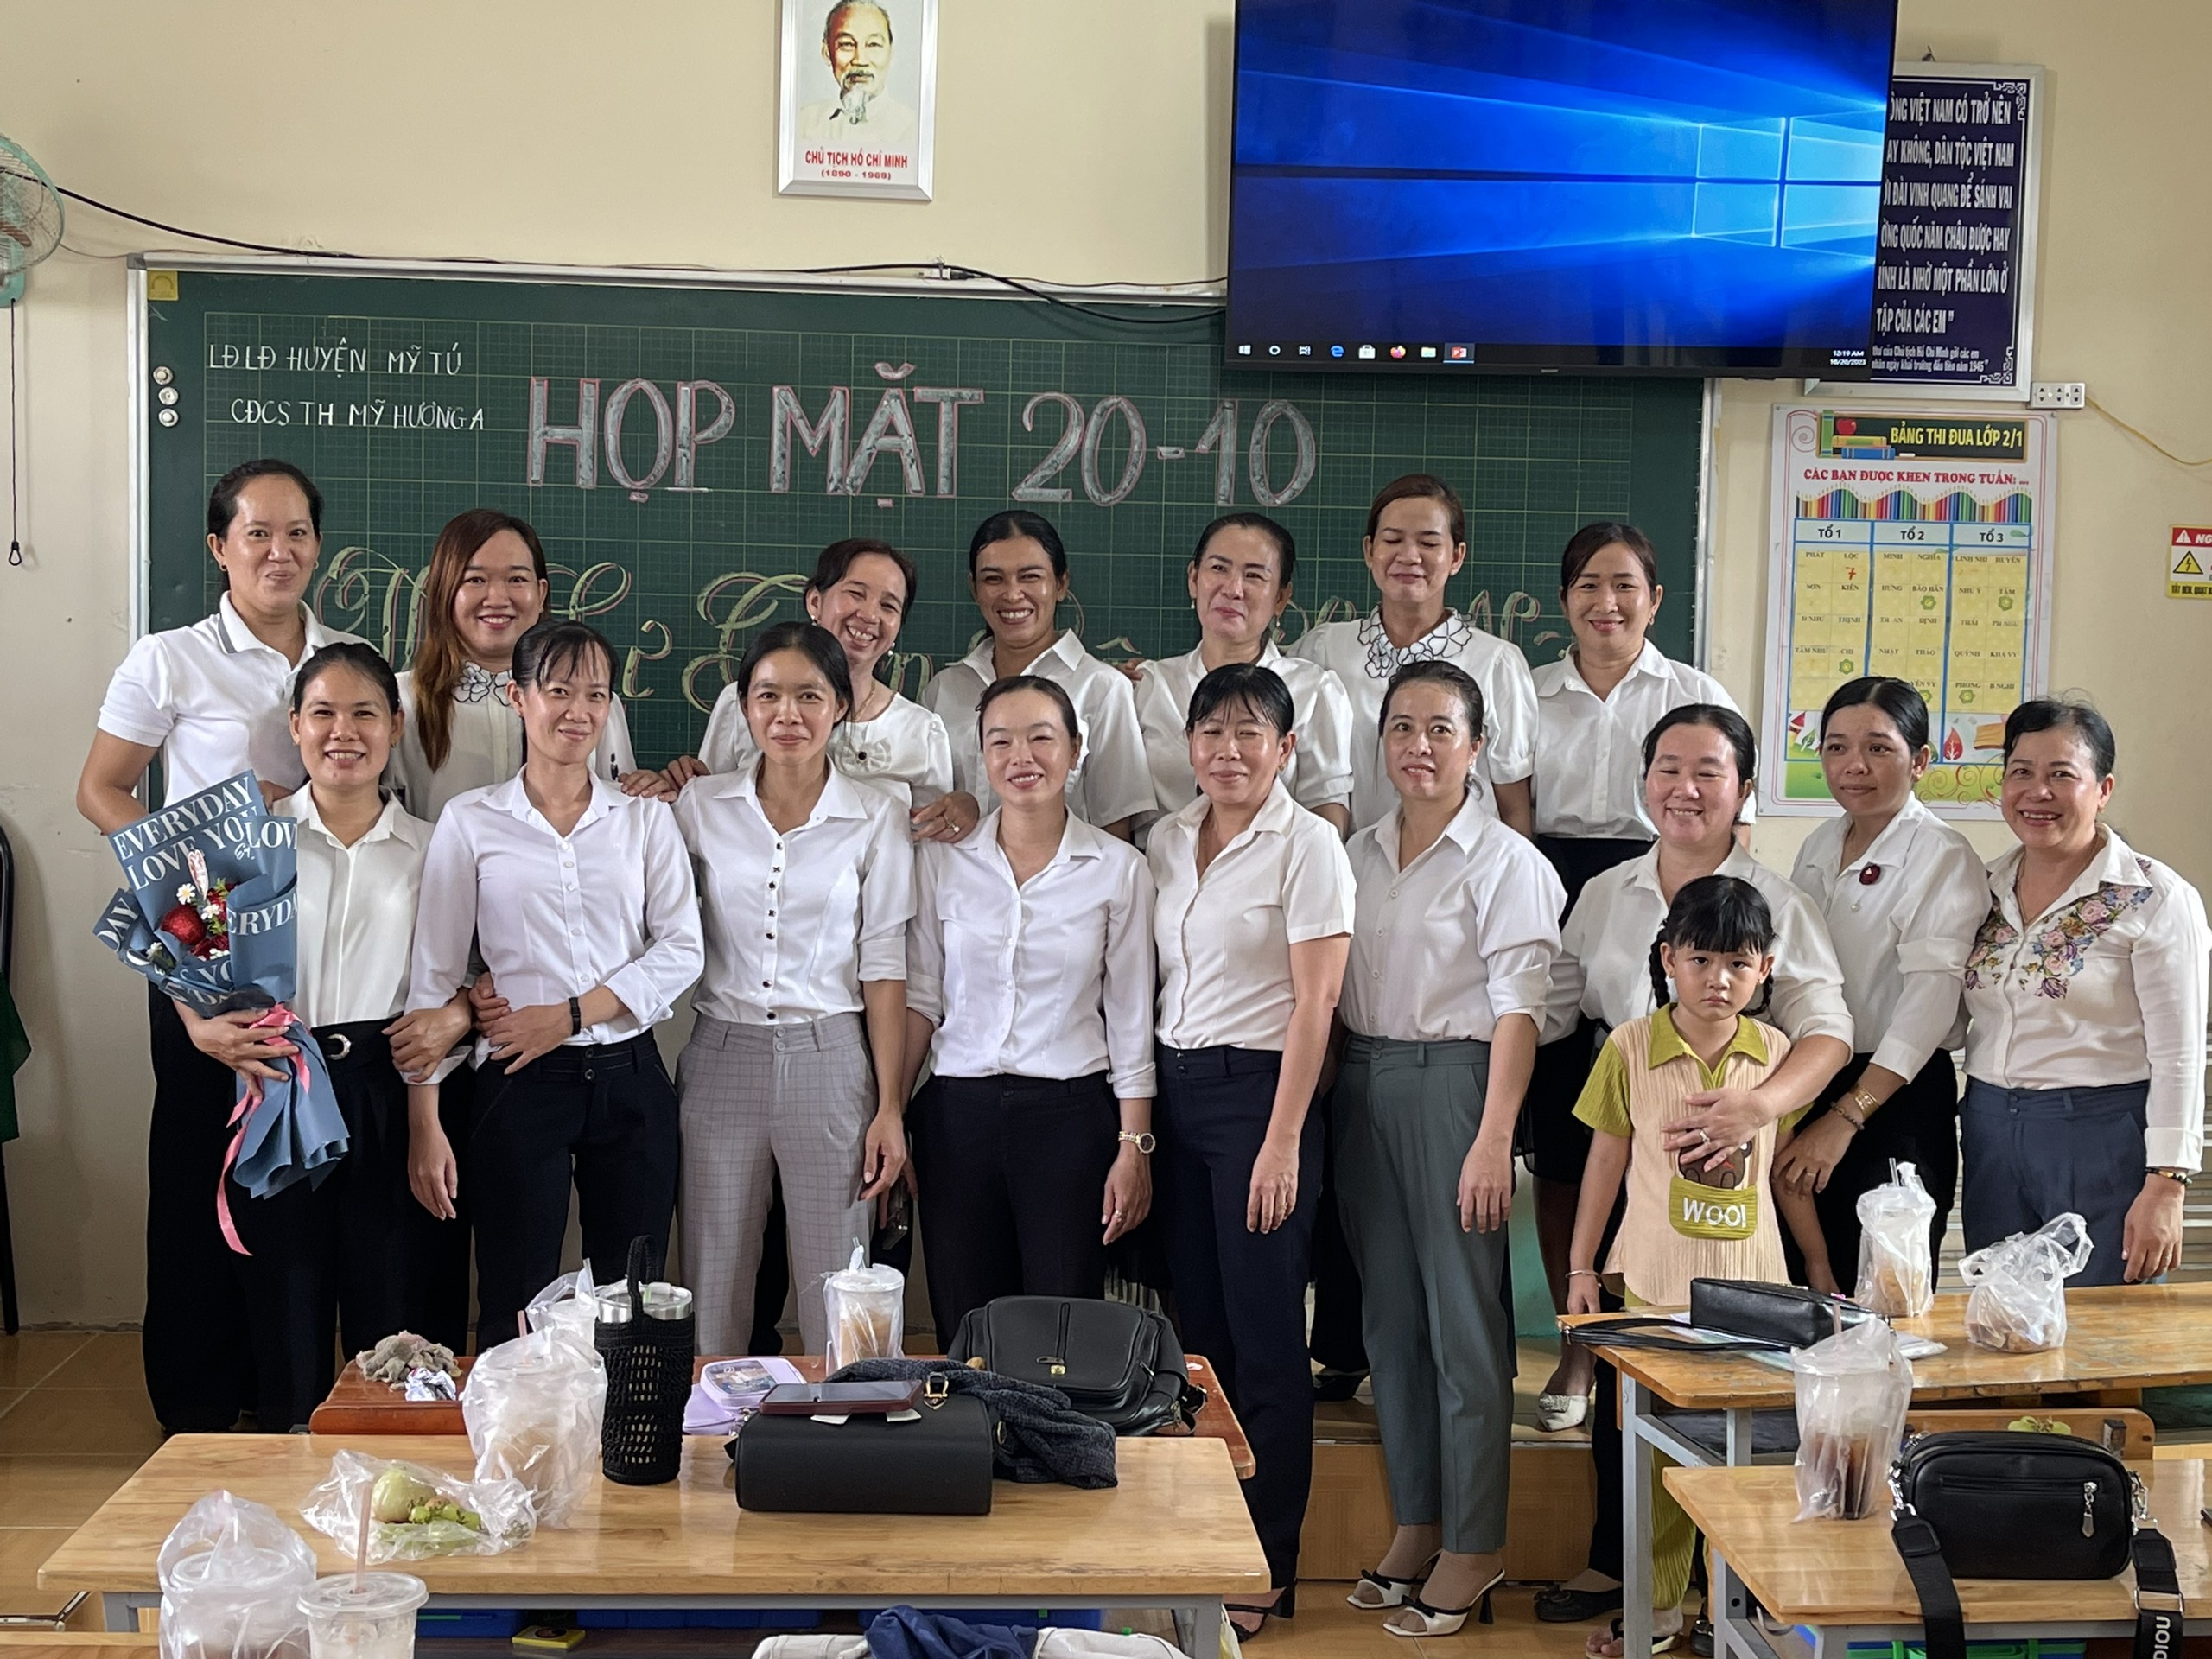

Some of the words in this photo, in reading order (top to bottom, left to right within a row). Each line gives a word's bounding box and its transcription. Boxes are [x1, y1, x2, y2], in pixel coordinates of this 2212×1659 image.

[1910, 92, 1931, 126] VIỆT
[1932, 99, 1953, 123] NAM
[1955, 92, 1968, 123] CÓ
[1971, 91, 1990, 124] TRỞ
[1992, 94, 2012, 124] NÊN
[805, 146, 824, 164] CHỦ
[827, 152, 849, 168] TỊCH
[851, 147, 863, 166] HỒ
[866, 150, 881, 167] CHÍ
[884, 155, 907, 168] MINH
[1886, 139, 1899, 163] AY
[1900, 133, 1932, 169] KHÔNG,
[1935, 135, 1953, 164] DÂN
[1955, 135, 1972, 169] TỘC
[1974, 136, 1993, 171] VIỆT
[1994, 143, 2015, 167] NAM
[1892, 175, 1908, 206] ĐÀI
[1910, 182, 1929, 207] VINH
[1930, 183, 1959, 211] QUANG
[1960, 171, 1974, 207] ĐỂ
[1974, 178, 1998, 209] SÁNH
[1999, 185, 2013, 209] VAI
[1900, 216, 1923, 252] QUỐC
[1923, 220, 1944, 249] NĂM
[1945, 219, 1968, 251] CHÂU
[1968, 222, 1993, 256] ĐƯỢC
[1993, 227, 2011, 251] HAY
[1898, 260, 1910, 290] LÀ
[1912, 261, 1932, 290] NHỜ
[1933, 261, 1953, 296] MỘT
[1980, 263, 1999, 293] LỚN
[2000, 260, 2009, 294] Ở
[1877, 302, 1894, 337] TẬP
[1895, 299, 1912, 333] CỦA
[1914, 302, 1932, 334] CÁC
[1932, 309, 1946, 334] EM
[286, 337, 366, 378] HUYỆN
[387, 344, 422, 374] MỸ
[429, 342, 461, 375] TÚ
[231, 398, 290, 427] CĐCS
[299, 401, 334, 426] TH
[349, 397, 385, 427] MỸ
[525, 376, 736, 505] HỌP
[769, 361, 985, 508] MẶT
[1010, 391, 1318, 508] 20-10
[1890, 420, 1923, 445] BẢNG
[1927, 428, 1946, 445] THI
[1949, 429, 1974, 446] ĐUA
[1976, 423, 1999, 447] LỚP
[2003, 429, 2023, 449] 2/1
[1804, 467, 1827, 480] CÁC
[1831, 470, 1857, 482] BẠN
[1897, 472, 1932, 483] KHEN
[1935, 473, 1976, 485] TRONG
[1818, 524, 1833, 538] TỔ
[1835, 530, 1841, 538] 1
[1900, 525, 1916, 540] TỔ
[1918, 531, 1924, 541] 2
[1979, 527, 1995, 543] TỔ
[1997, 532, 2004, 543] 3
[113, 776, 253, 861] EVERYDAY
